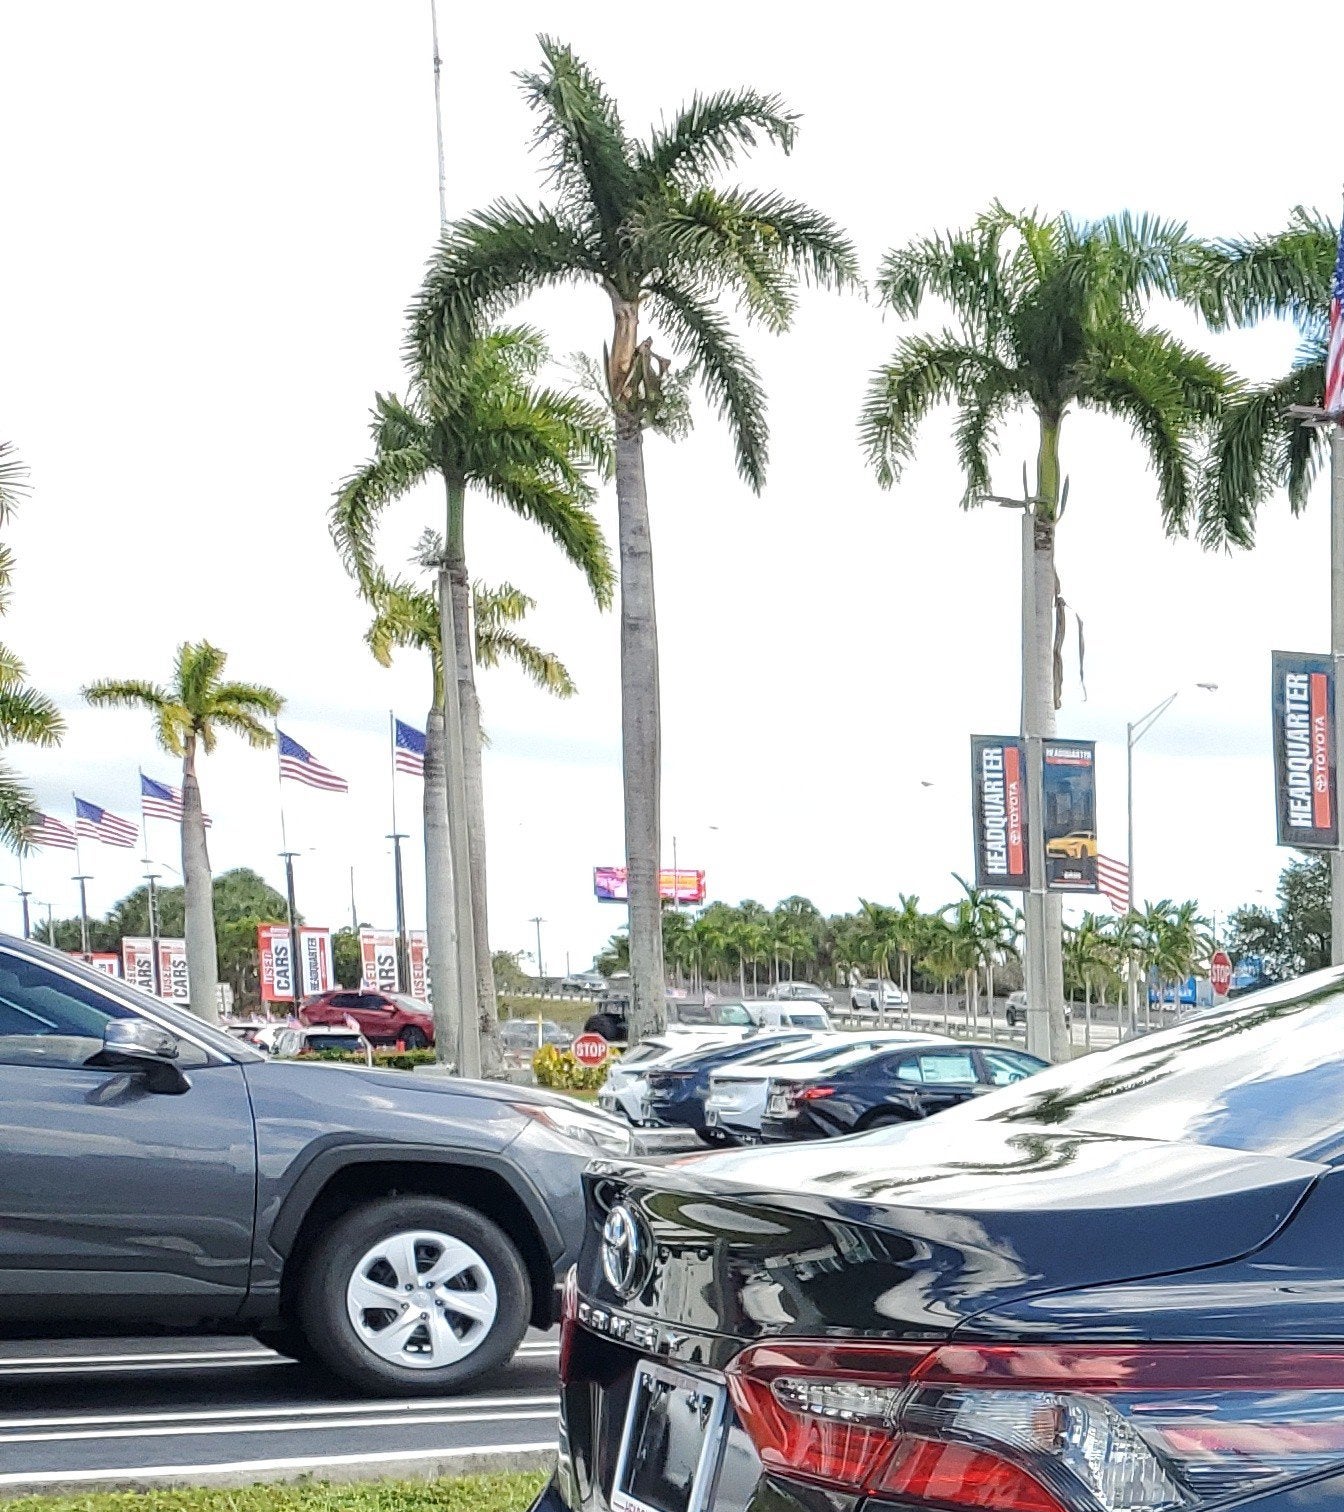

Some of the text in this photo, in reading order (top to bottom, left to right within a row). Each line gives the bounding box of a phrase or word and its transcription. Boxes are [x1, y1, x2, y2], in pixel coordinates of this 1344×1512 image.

[1286, 671, 1312, 828] HEADQUARTER
[1314, 716, 1326, 772] TOYOTA
[983, 747, 1008, 875] HEADQUARTER
[1009, 783, 1019, 828] TOYOTA
[137, 959, 152, 993] ARS
[173, 959, 188, 998] CARS
[263, 951, 274, 983] USED
[274, 945, 290, 991] CARS
[377, 954, 396, 993] ARS
[413, 963, 424, 996] USED
[1211, 964, 1231, 983] STOP
[576, 1043, 607, 1058] STOP
[578, 1302, 691, 1351] CAMRY
